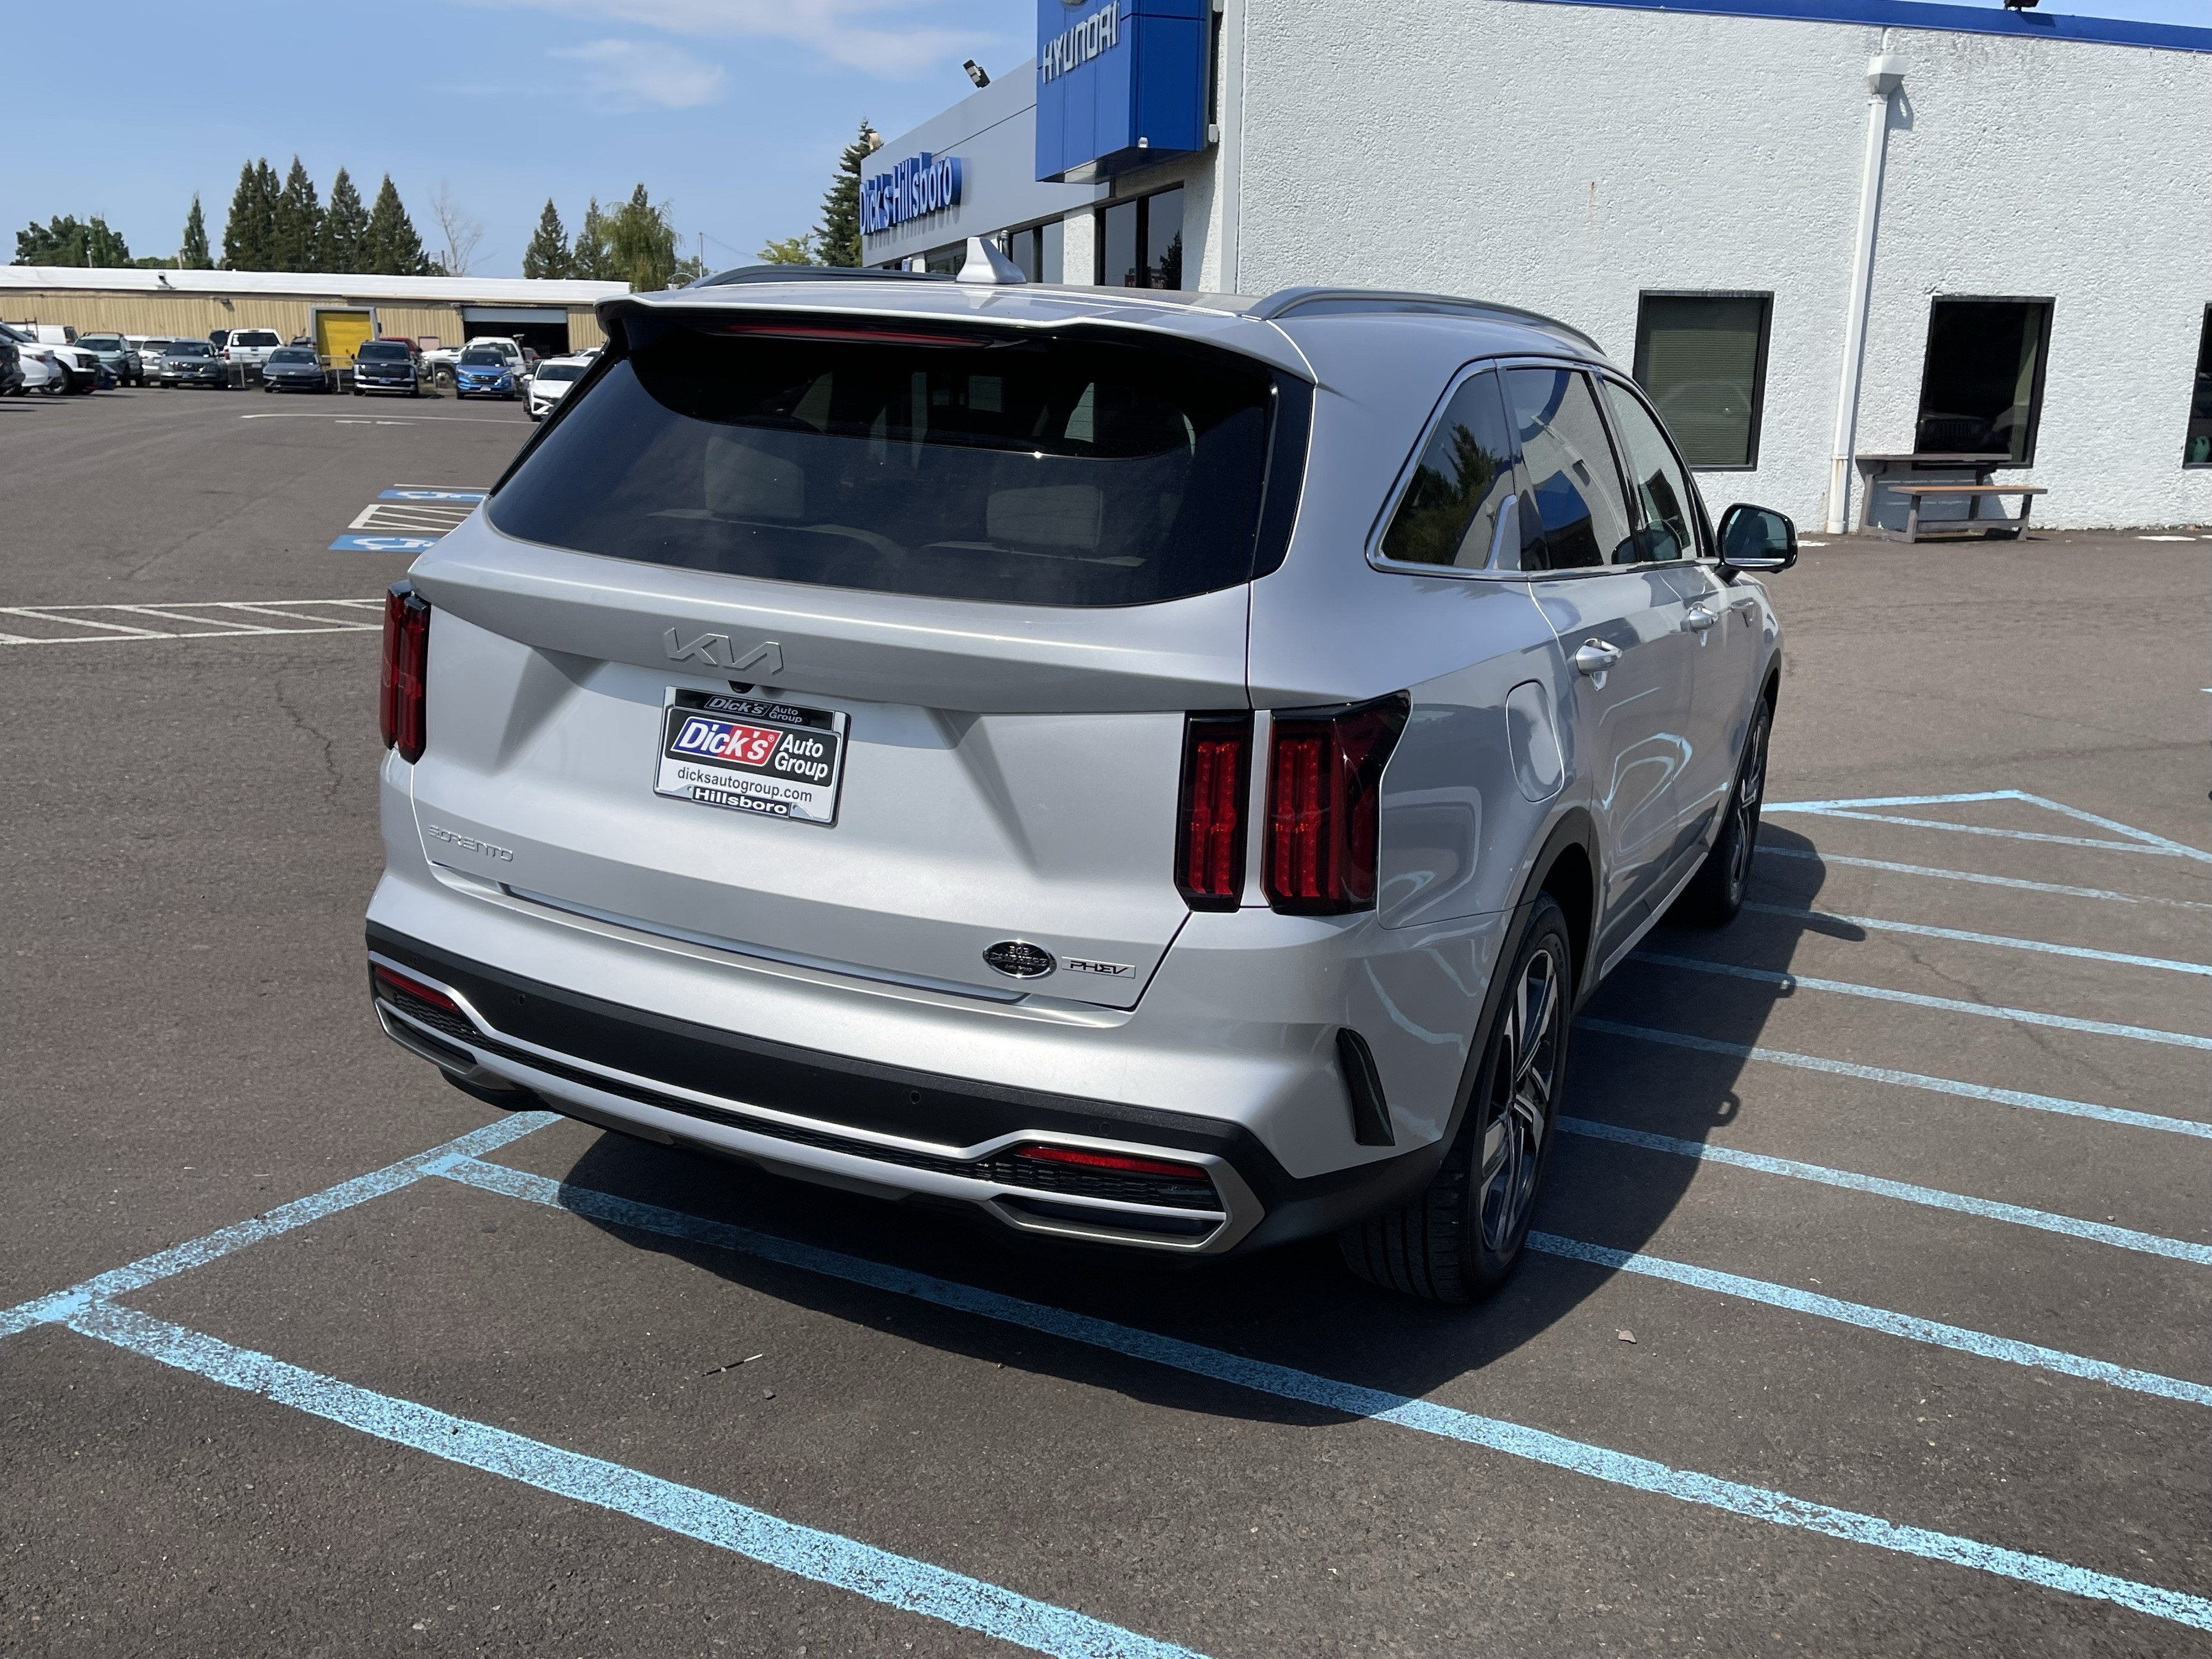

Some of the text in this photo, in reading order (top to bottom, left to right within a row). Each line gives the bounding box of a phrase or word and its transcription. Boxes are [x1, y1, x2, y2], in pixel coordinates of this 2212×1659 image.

[1043, 1, 1119, 84] HYUNDAI
[859, 152, 958, 236] Dick's Hillsboro
[769, 711, 803, 724] Group
[772, 706, 799, 716] Auto
[779, 733, 823, 758] Auto
[774, 751, 828, 781] Group
[678, 766, 812, 803] dicksautogroup.com
[695, 787, 788, 815] Hillsboro
[428, 824, 514, 862] SORENTO
[1070, 960, 1129, 975] PHEV
